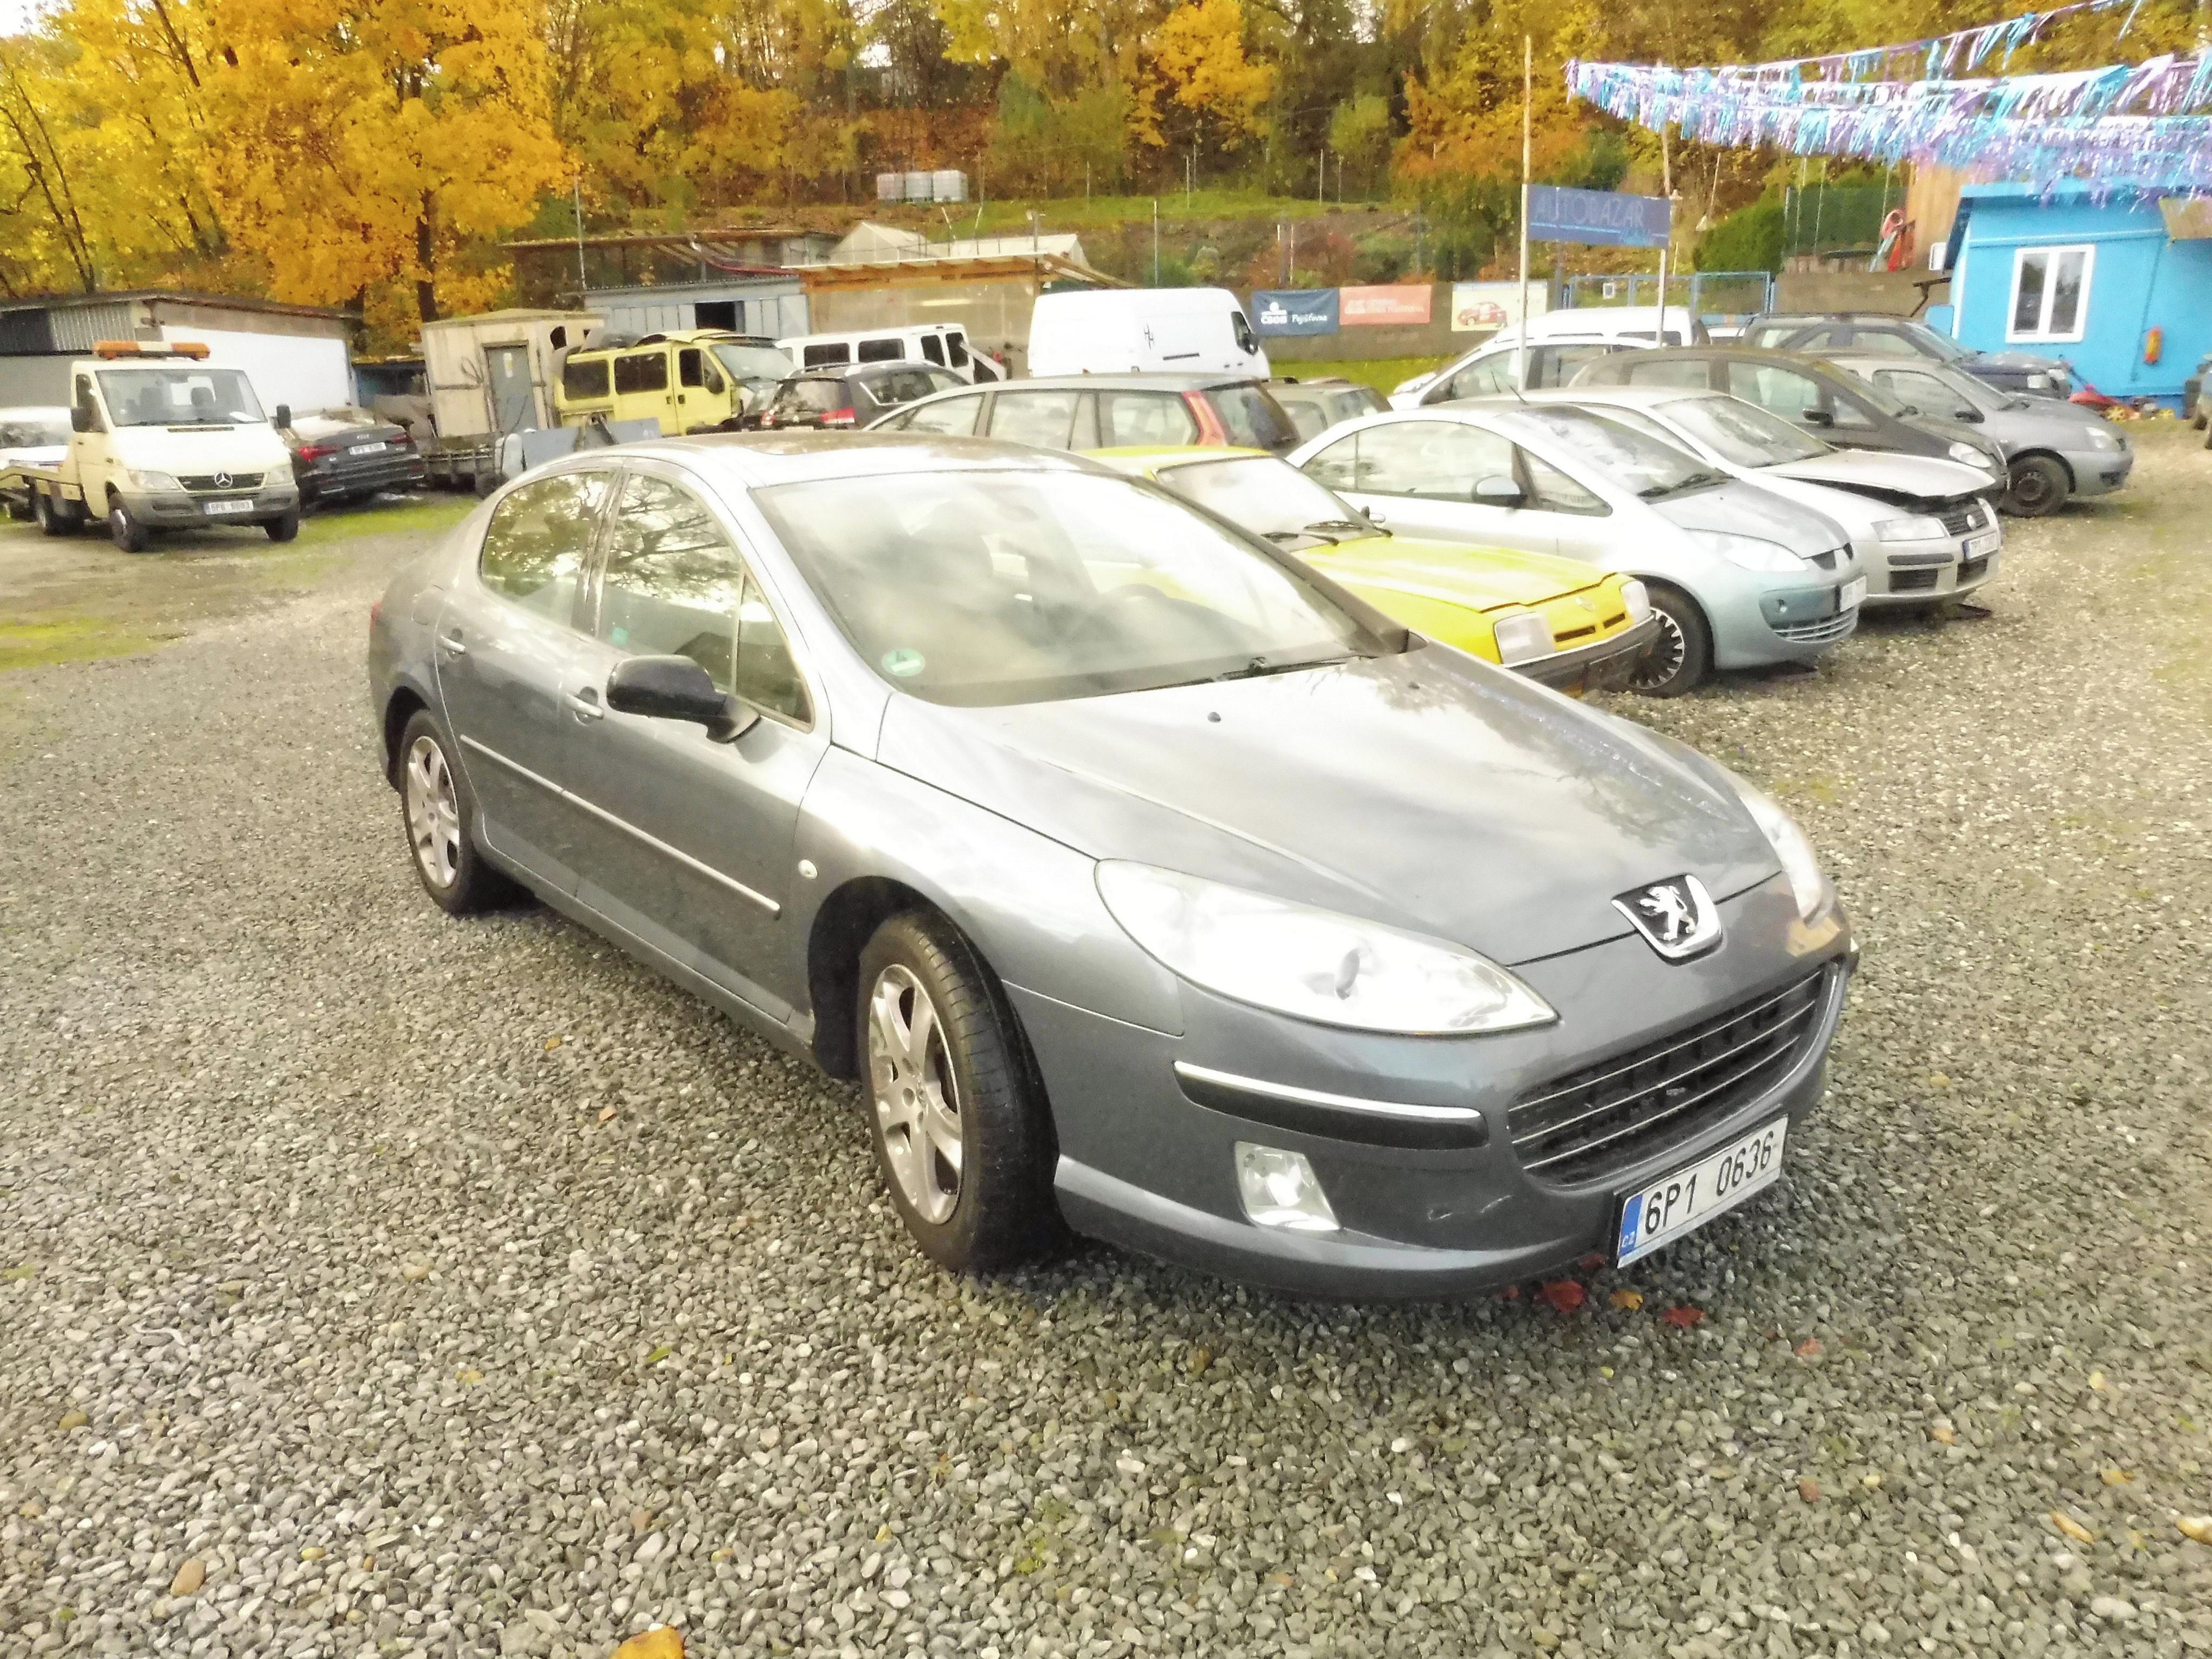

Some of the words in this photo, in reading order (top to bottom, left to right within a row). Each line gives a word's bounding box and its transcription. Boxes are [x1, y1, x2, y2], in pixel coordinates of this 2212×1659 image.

[1645, 1174, 1697, 1235] 6P1
[1717, 1131, 1773, 1196] 0636
[1622, 1231, 1636, 1248] CZ
